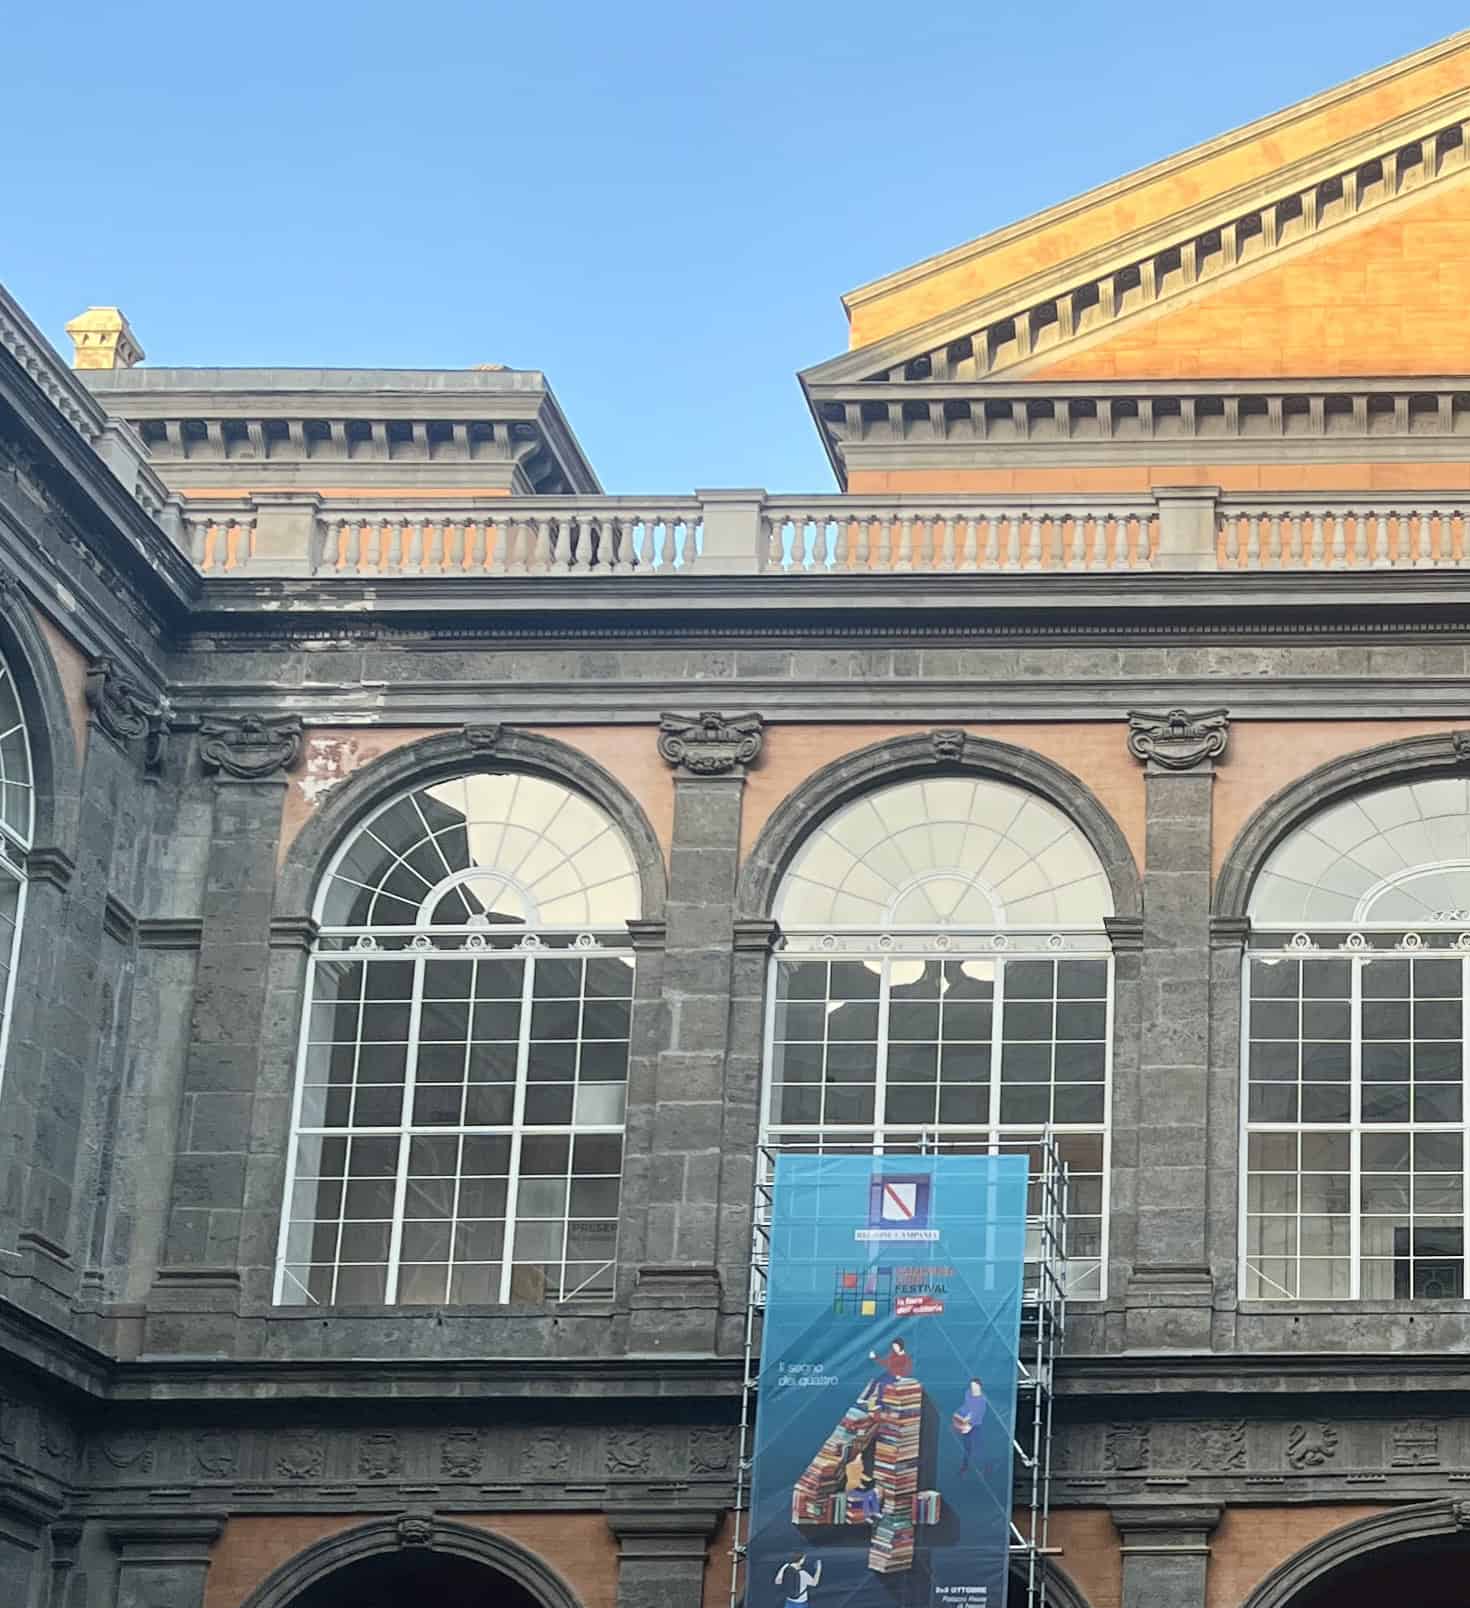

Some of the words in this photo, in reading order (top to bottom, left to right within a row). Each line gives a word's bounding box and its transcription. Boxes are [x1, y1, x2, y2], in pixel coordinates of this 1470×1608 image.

[896, 1284, 948, 1294] FESTIVAL
[788, 1363, 824, 1377] segno
[798, 1375, 840, 1389] quattro
